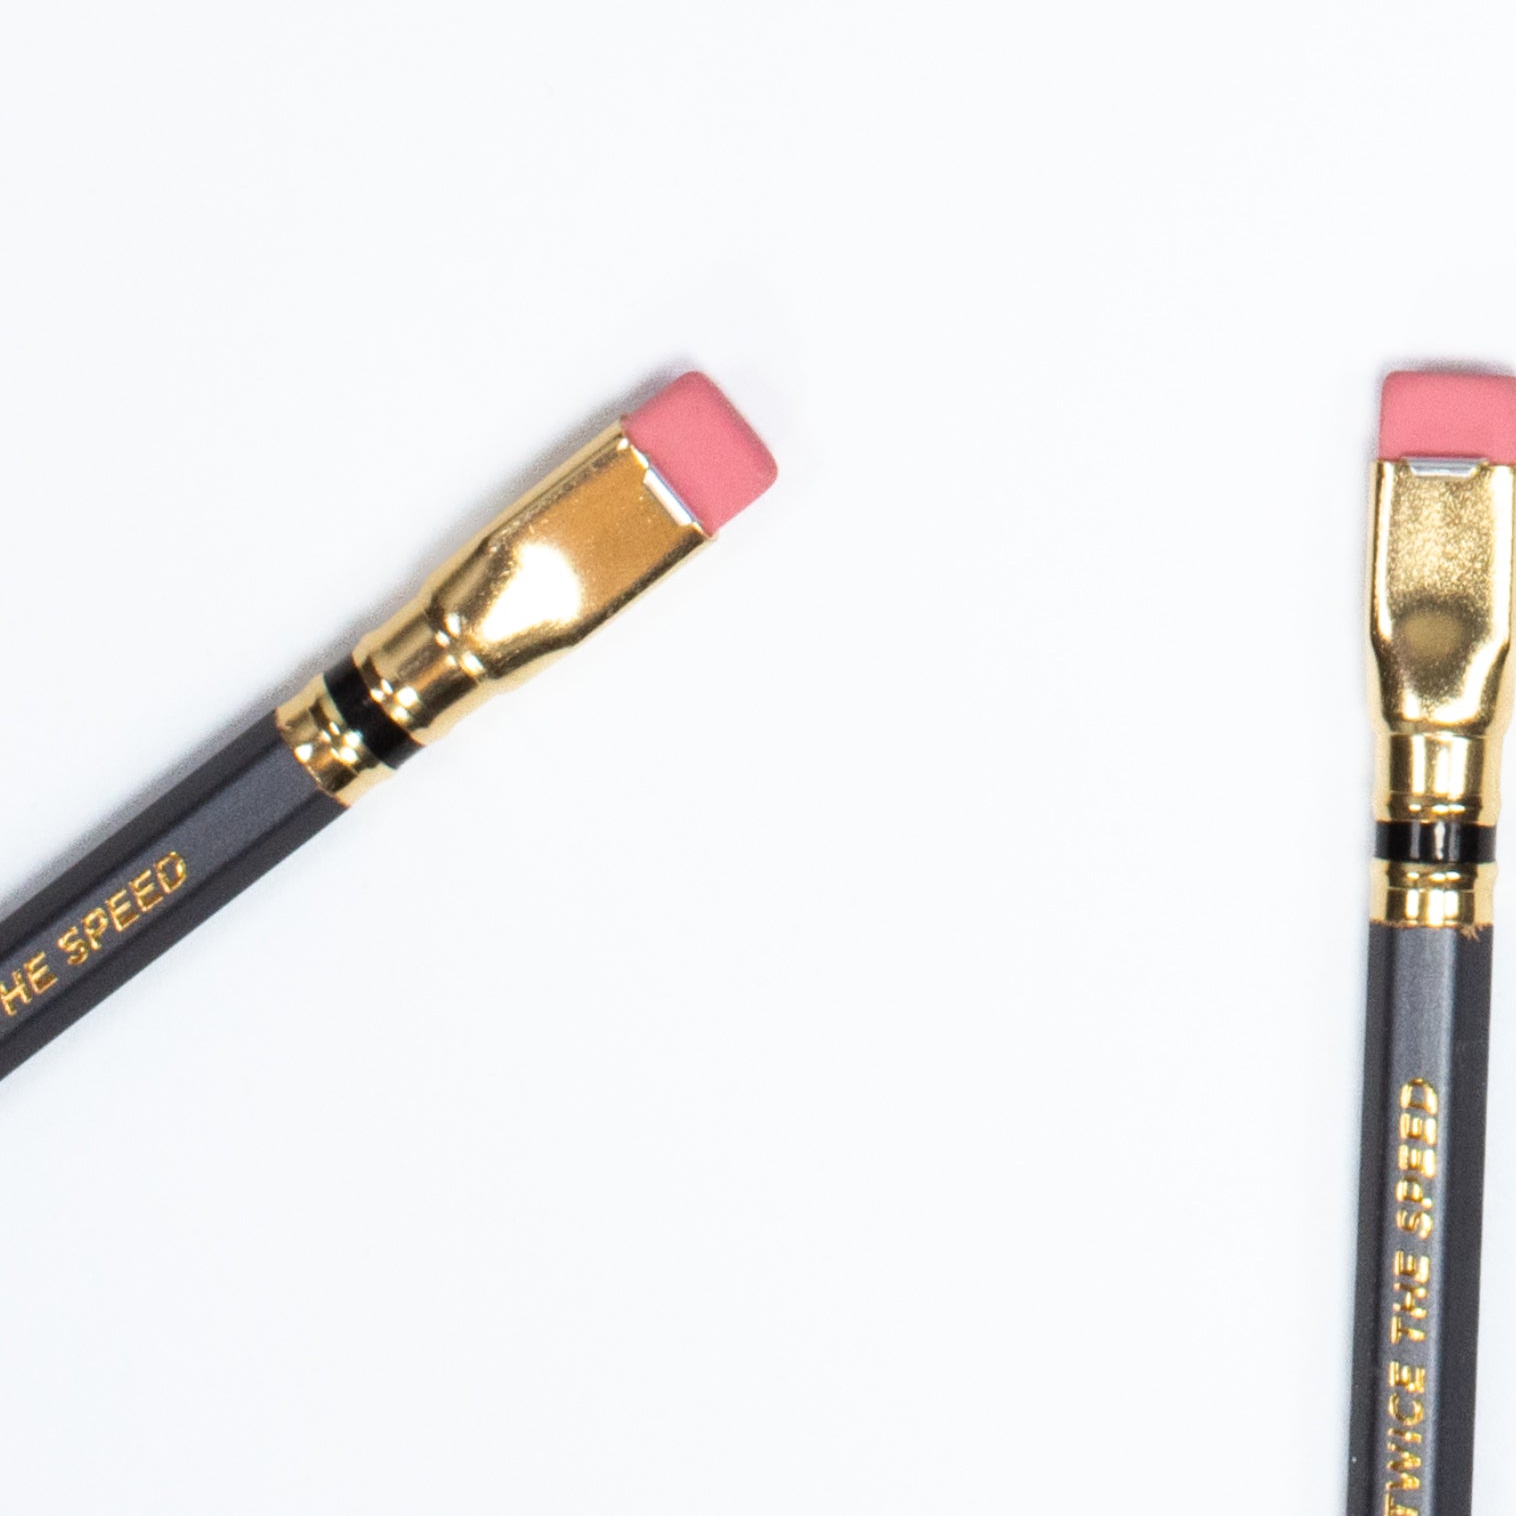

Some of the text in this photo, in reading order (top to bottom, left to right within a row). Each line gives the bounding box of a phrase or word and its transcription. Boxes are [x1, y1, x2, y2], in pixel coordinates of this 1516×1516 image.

[56, 850, 188, 965] SPEED
[1384, 1078, 1438, 1516] TWICE THE SPEED
